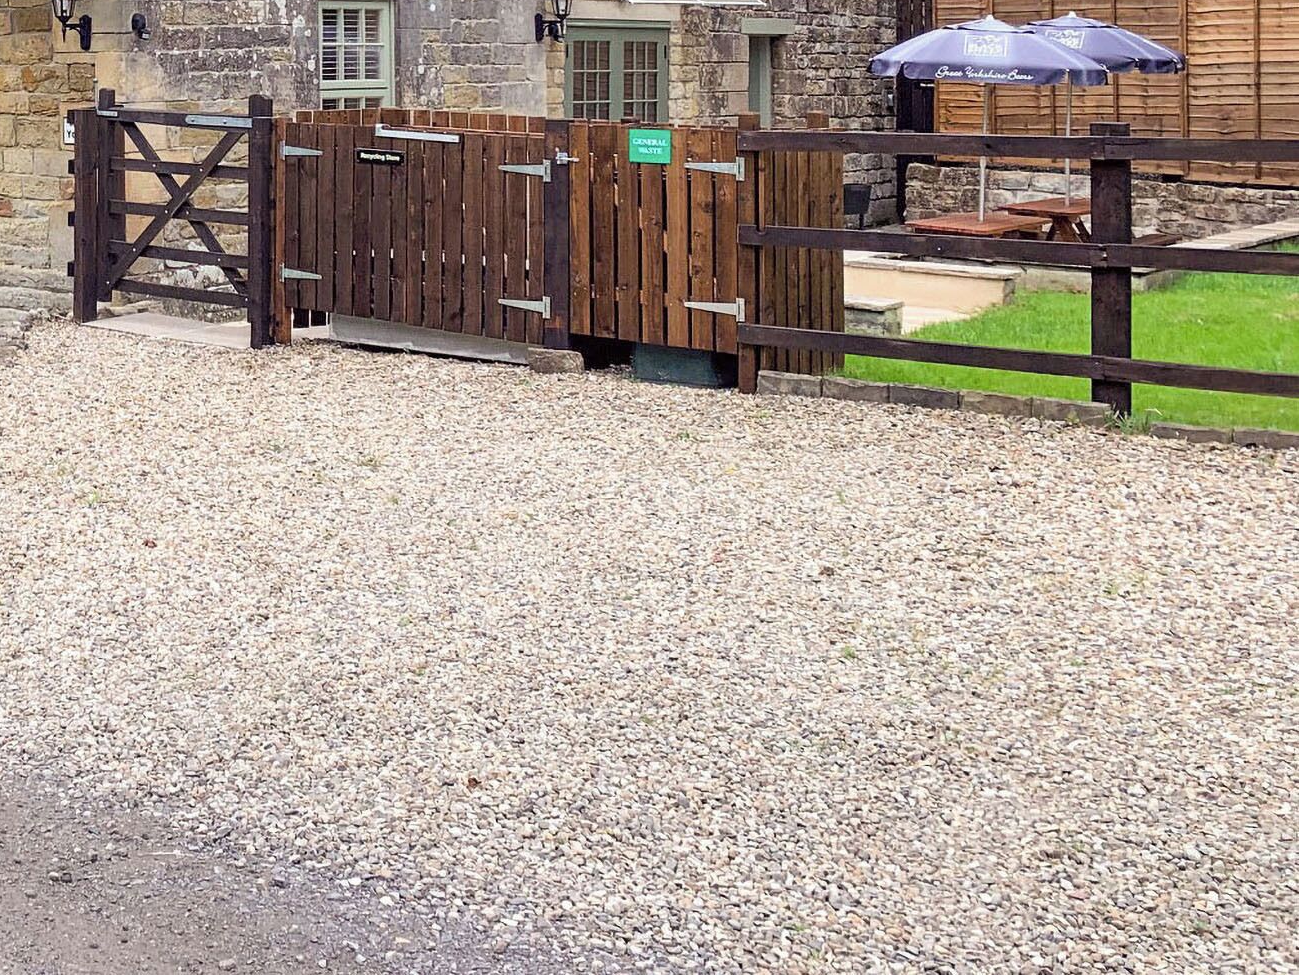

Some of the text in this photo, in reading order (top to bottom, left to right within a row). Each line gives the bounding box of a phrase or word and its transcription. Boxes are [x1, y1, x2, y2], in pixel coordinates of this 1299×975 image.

[964, 65, 1007, 79] Yorkshire
[632, 138, 668, 146] GENERAL
[637, 146, 663, 154] WASTE
